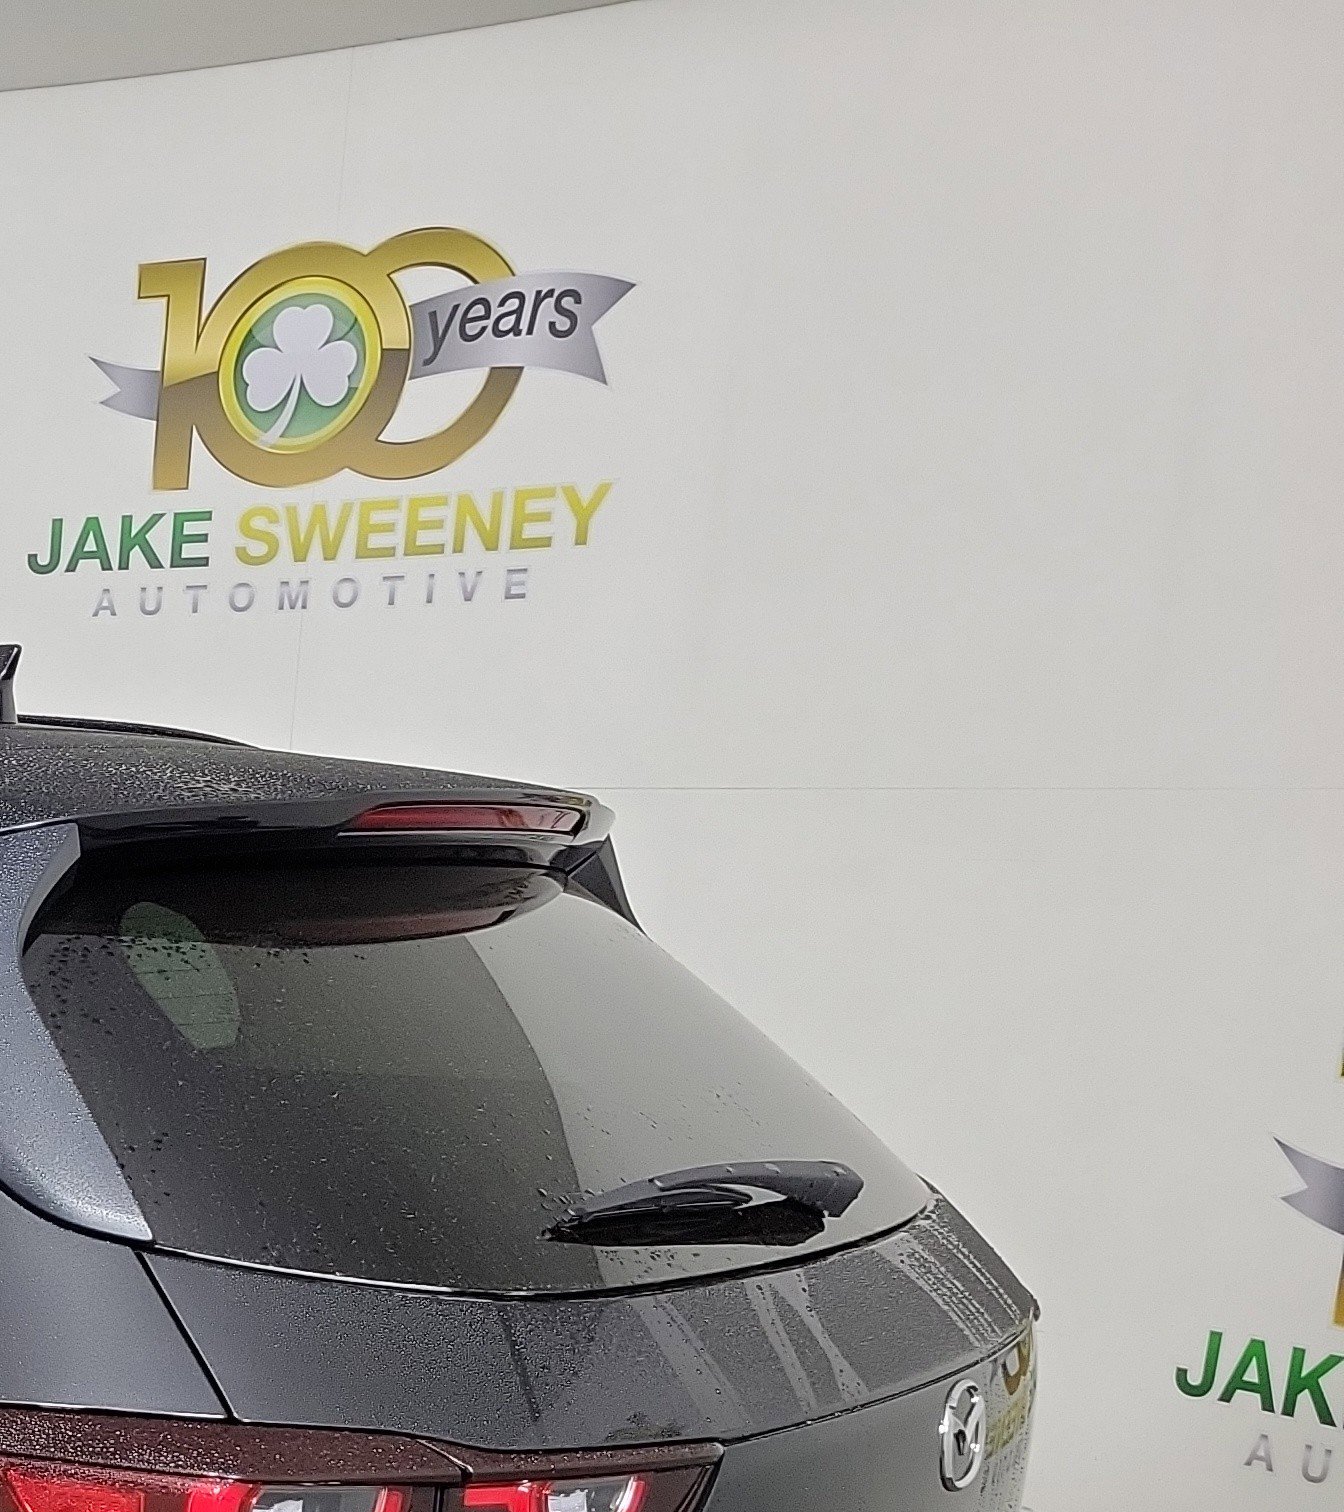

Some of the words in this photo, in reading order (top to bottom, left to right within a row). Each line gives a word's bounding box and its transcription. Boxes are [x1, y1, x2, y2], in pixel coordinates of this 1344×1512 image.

[137, 226, 523, 491] 100
[423, 287, 582, 367] years
[27, 510, 213, 575] JAKE
[233, 481, 614, 567] SWEENEY
[92, 567, 530, 618] AUTOMOTIVE
[1175, 1330, 1344, 1428] JAK
